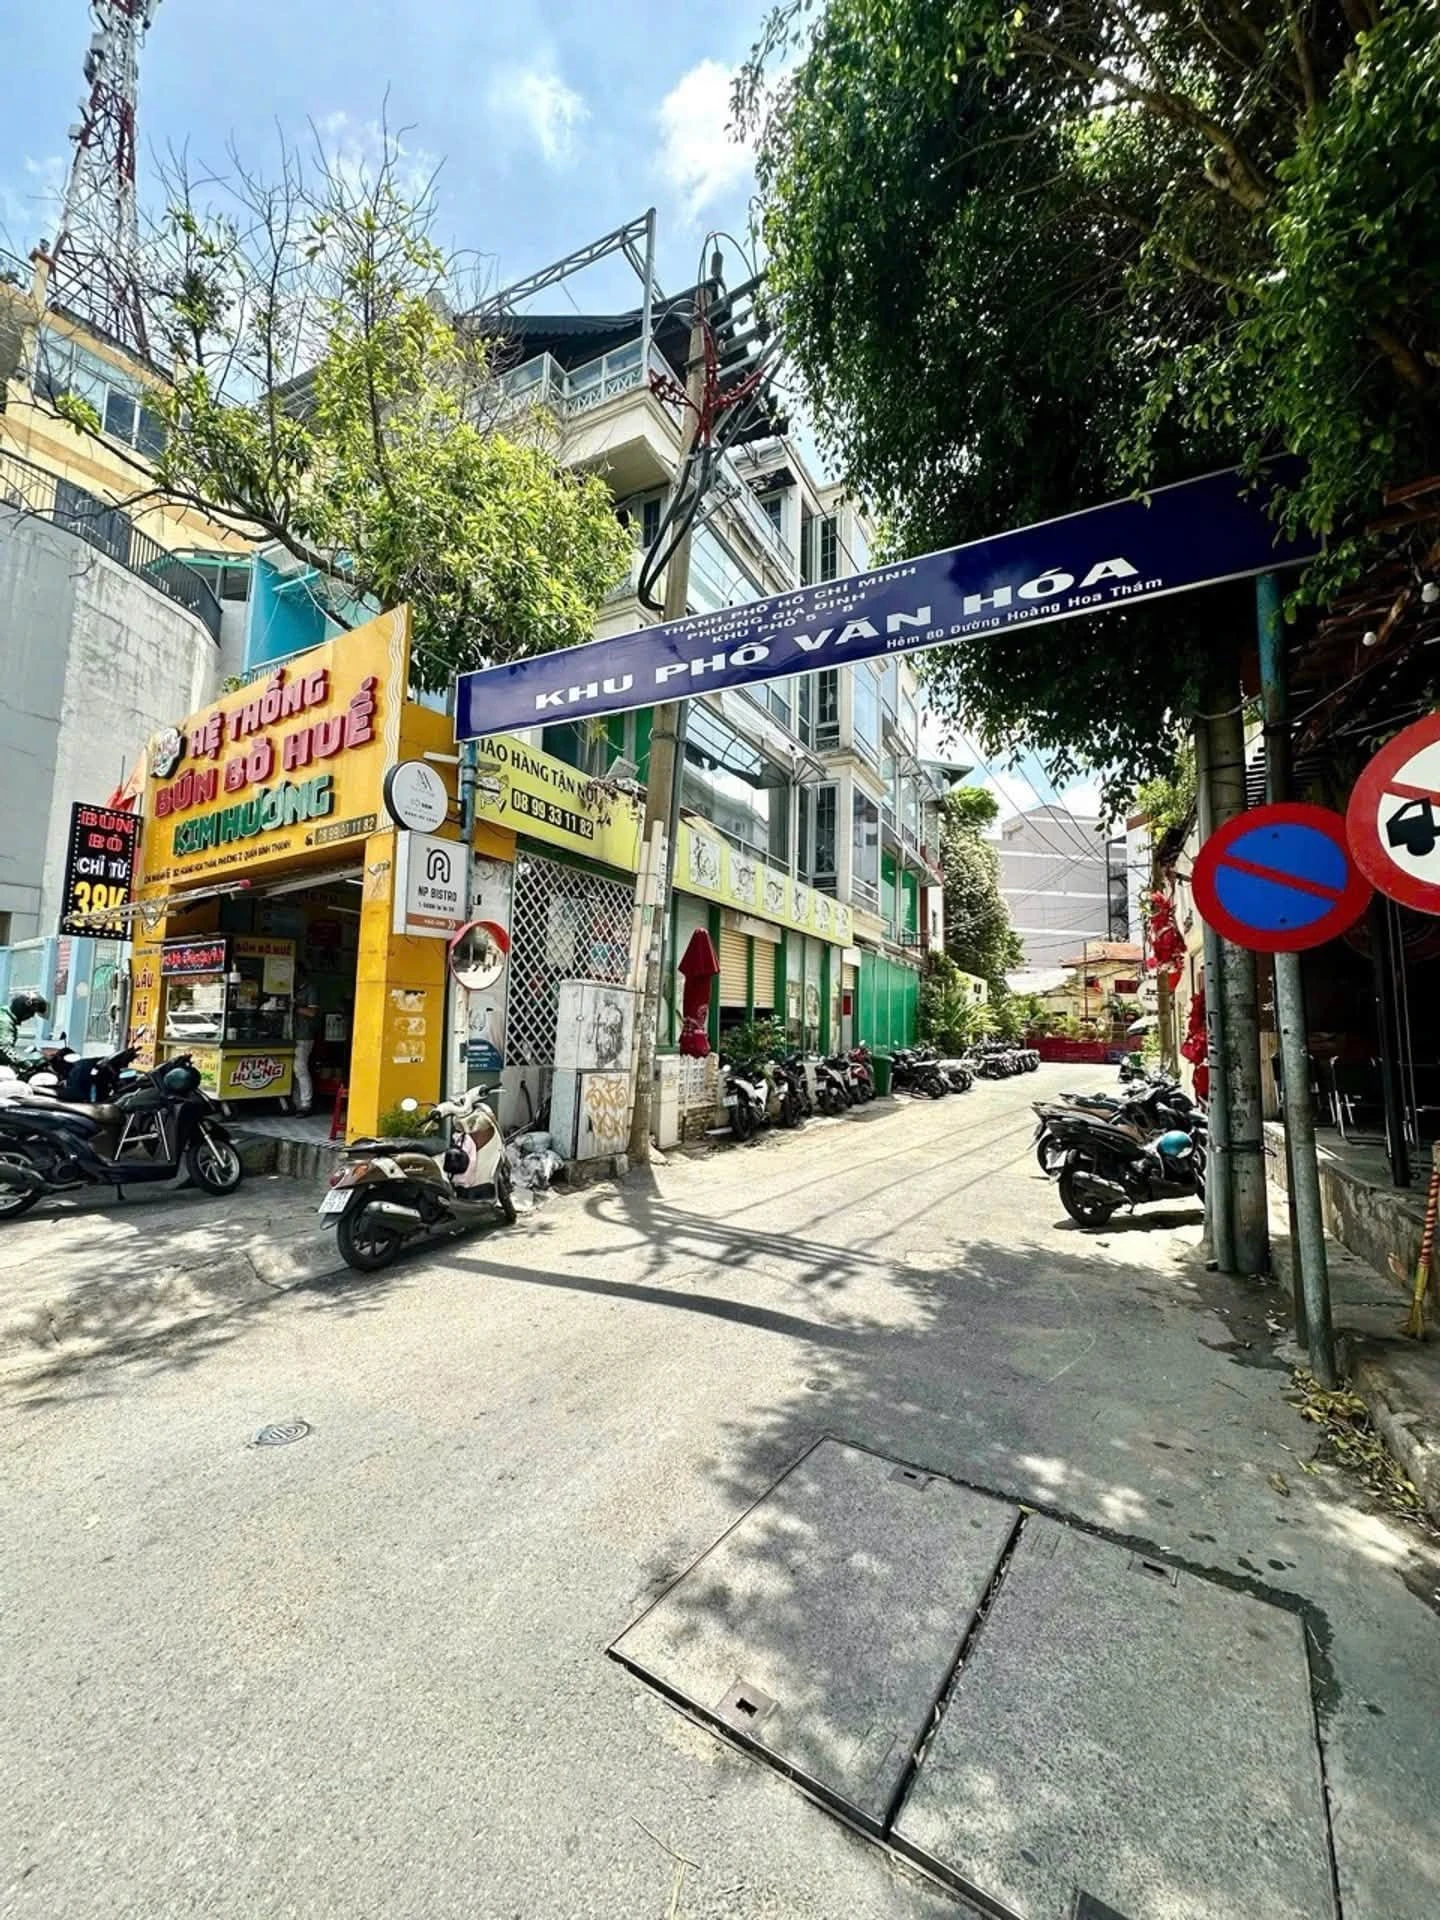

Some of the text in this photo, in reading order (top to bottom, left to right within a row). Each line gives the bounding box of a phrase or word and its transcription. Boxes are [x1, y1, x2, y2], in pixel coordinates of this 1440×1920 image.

[662, 615, 723, 637] THÀNH
[731, 600, 768, 619] PHỐ
[814, 581, 848, 601] CHÍ
[858, 567, 916, 589] MINH
[711, 628, 749, 644] KHU
[757, 616, 799, 634] PHỐ
[805, 612, 817, 622] 5
[842, 603, 854, 613] 8
[771, 606, 805, 624] GIA
[814, 592, 866, 613] ĐỊNH
[925, 627, 945, 640] 80
[949, 616, 1000, 635] Đường
[1006, 600, 1060, 622] Hoàng
[1067, 591, 1103, 608] Hoa
[1109, 577, 1163, 599] Thám
[534, 556, 1140, 711] KHU PHỐ VĂN HÓA
[190, 667, 329, 759] HỆ THỐNG
[155, 675, 378, 818] BÚN BÒ HUẾ
[477, 738, 508, 762] IAO
[511, 748, 549, 782] HÀNG
[551, 768, 576, 793] TẬN
[173, 774, 335, 858] KIM HƯƠNG
[362, 815, 375, 832] 82
[513, 791, 593, 839] 08 99 33 11 82
[78, 854, 106, 876] CHỈ
[109, 857, 128, 879] TỪ
[73, 880, 128, 933] 38K
[417, 884, 457, 903] NP BISTRO
[240, 1057, 269, 1072] KIM
